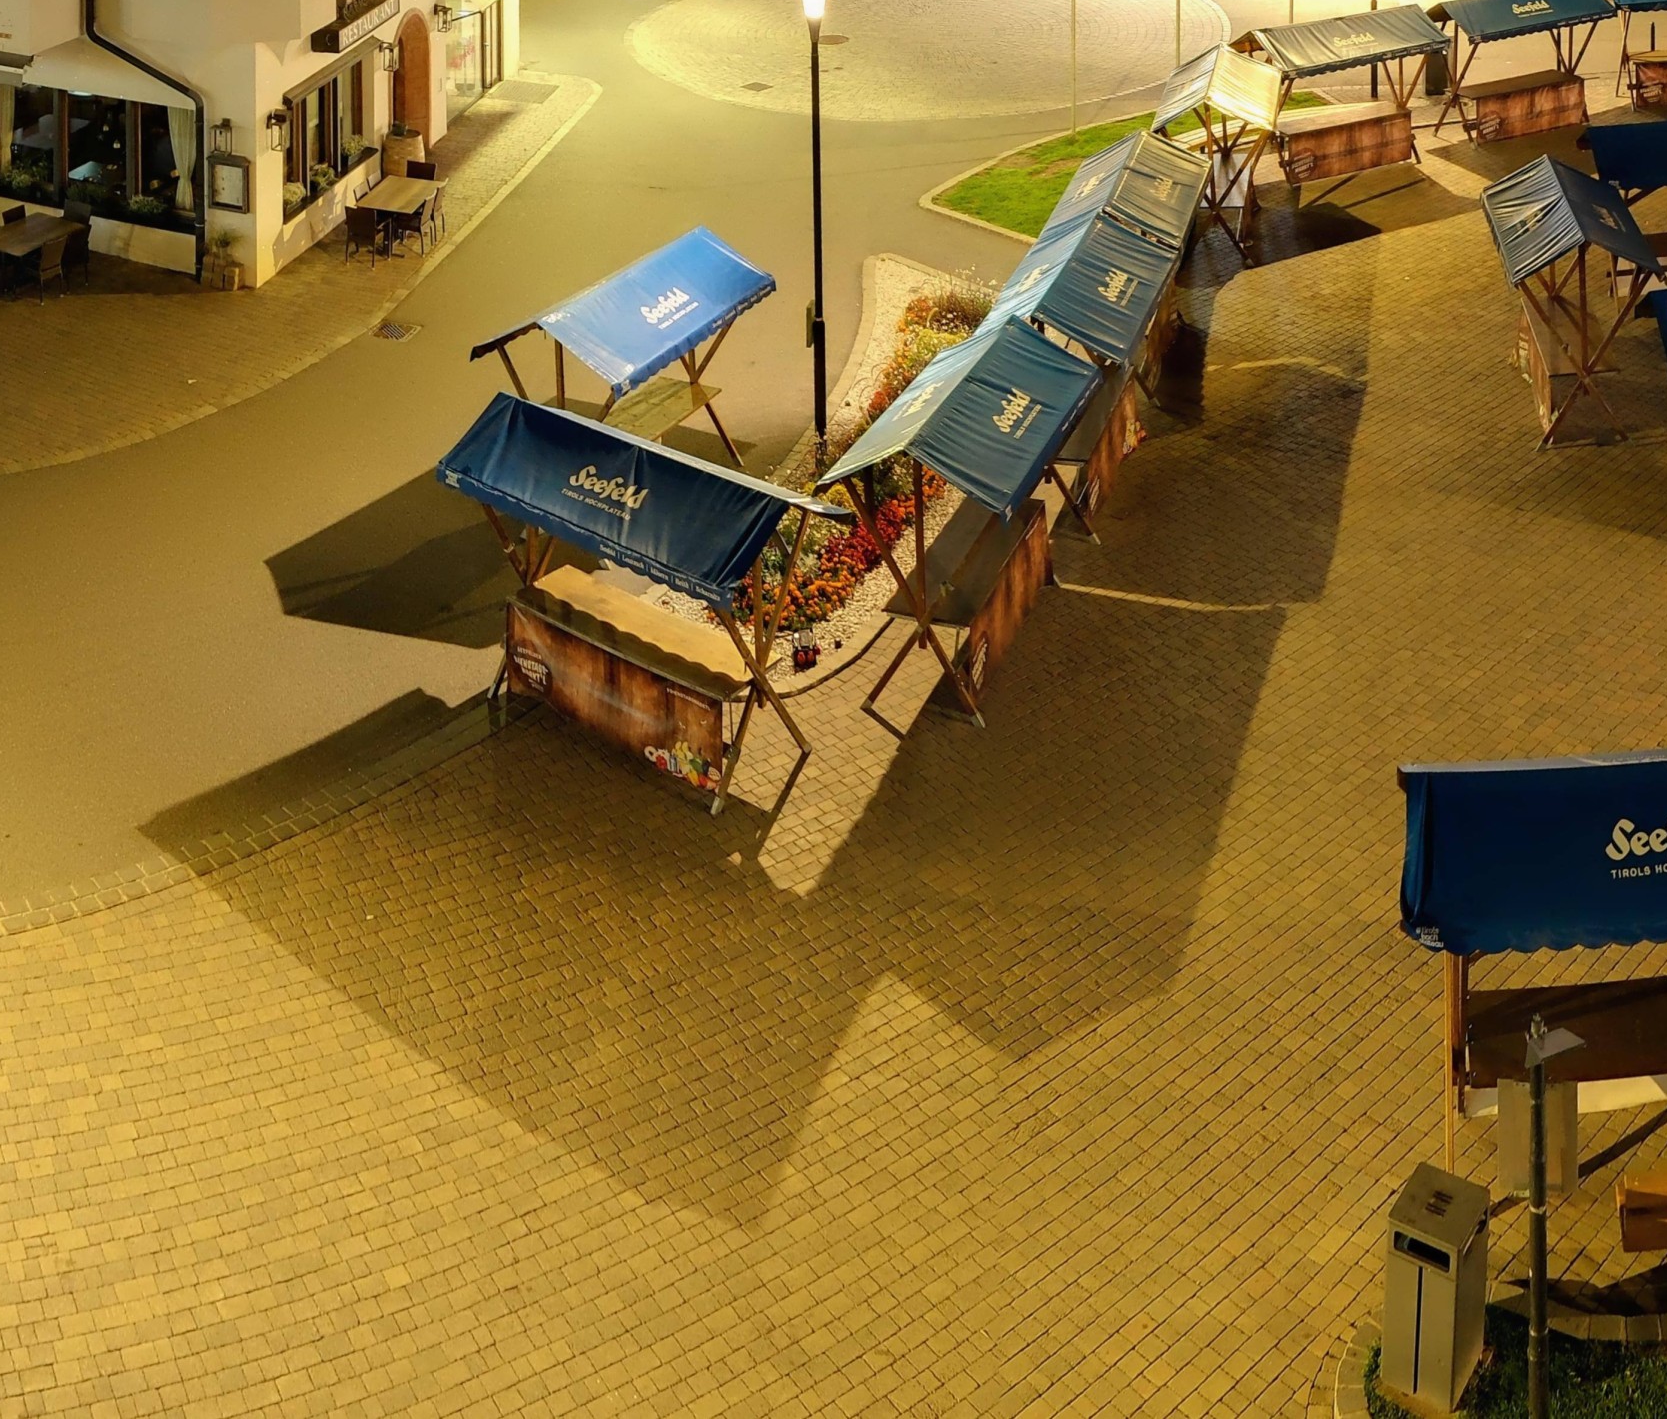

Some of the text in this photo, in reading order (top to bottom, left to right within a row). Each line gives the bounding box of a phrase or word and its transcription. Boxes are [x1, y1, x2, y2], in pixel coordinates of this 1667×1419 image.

[341, 0, 396, 47] RESTAURANT
[1511, 0, 1550, 16] Seefeld
[1333, 31, 1375, 48] Seefeld
[640, 287, 691, 324] Seefeld
[992, 386, 1032, 434] Seefeld
[561, 488, 632, 521] TIROLS HOCHPLATEAU
[569, 465, 649, 510] Seefeld
[1610, 866, 1651, 880] TIROLS
